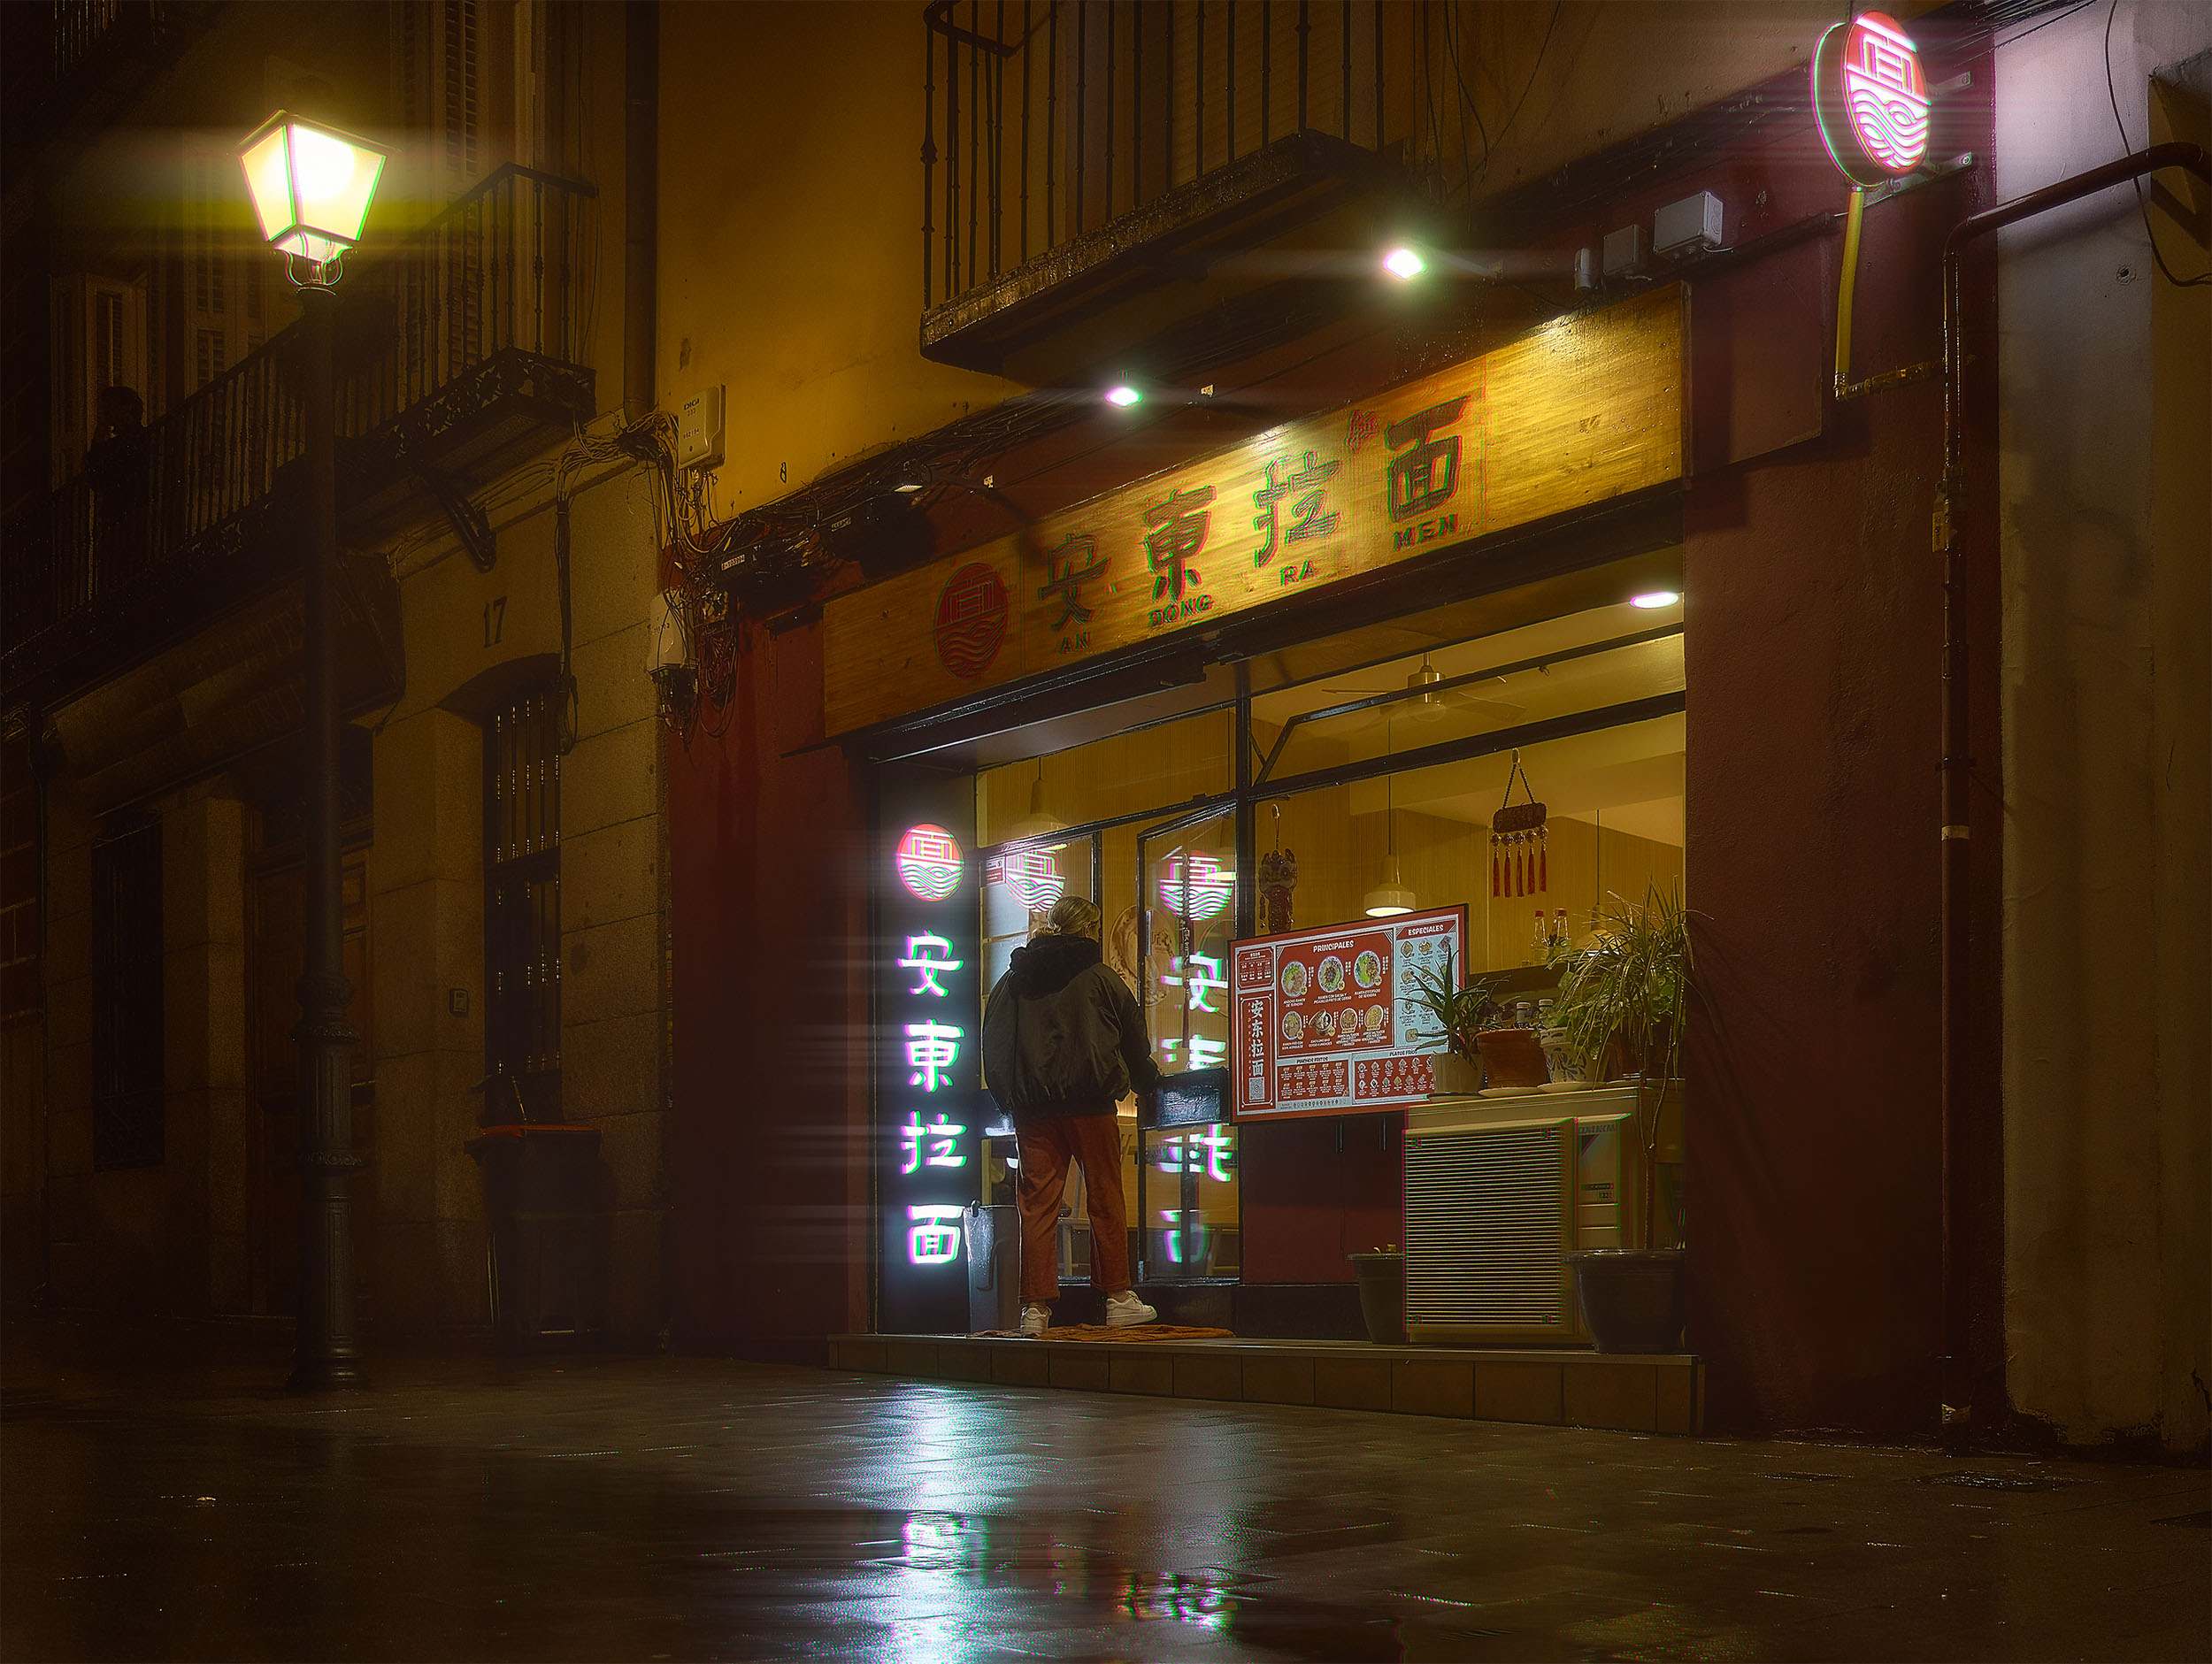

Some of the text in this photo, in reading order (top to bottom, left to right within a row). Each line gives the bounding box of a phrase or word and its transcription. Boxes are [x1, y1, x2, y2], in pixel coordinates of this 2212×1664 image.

[683, 397, 700, 410] DIGI
[1058, 512, 1459, 655] AN DONG RA MEN
[483, 595, 508, 648] 17
[1312, 939, 1355, 954] PRINCIPALES
[1407, 924, 1445, 937] ESPECIALES
[1251, 999, 1265, 1077] 安东拉面
[896, 930, 967, 1264] 安東拉面
